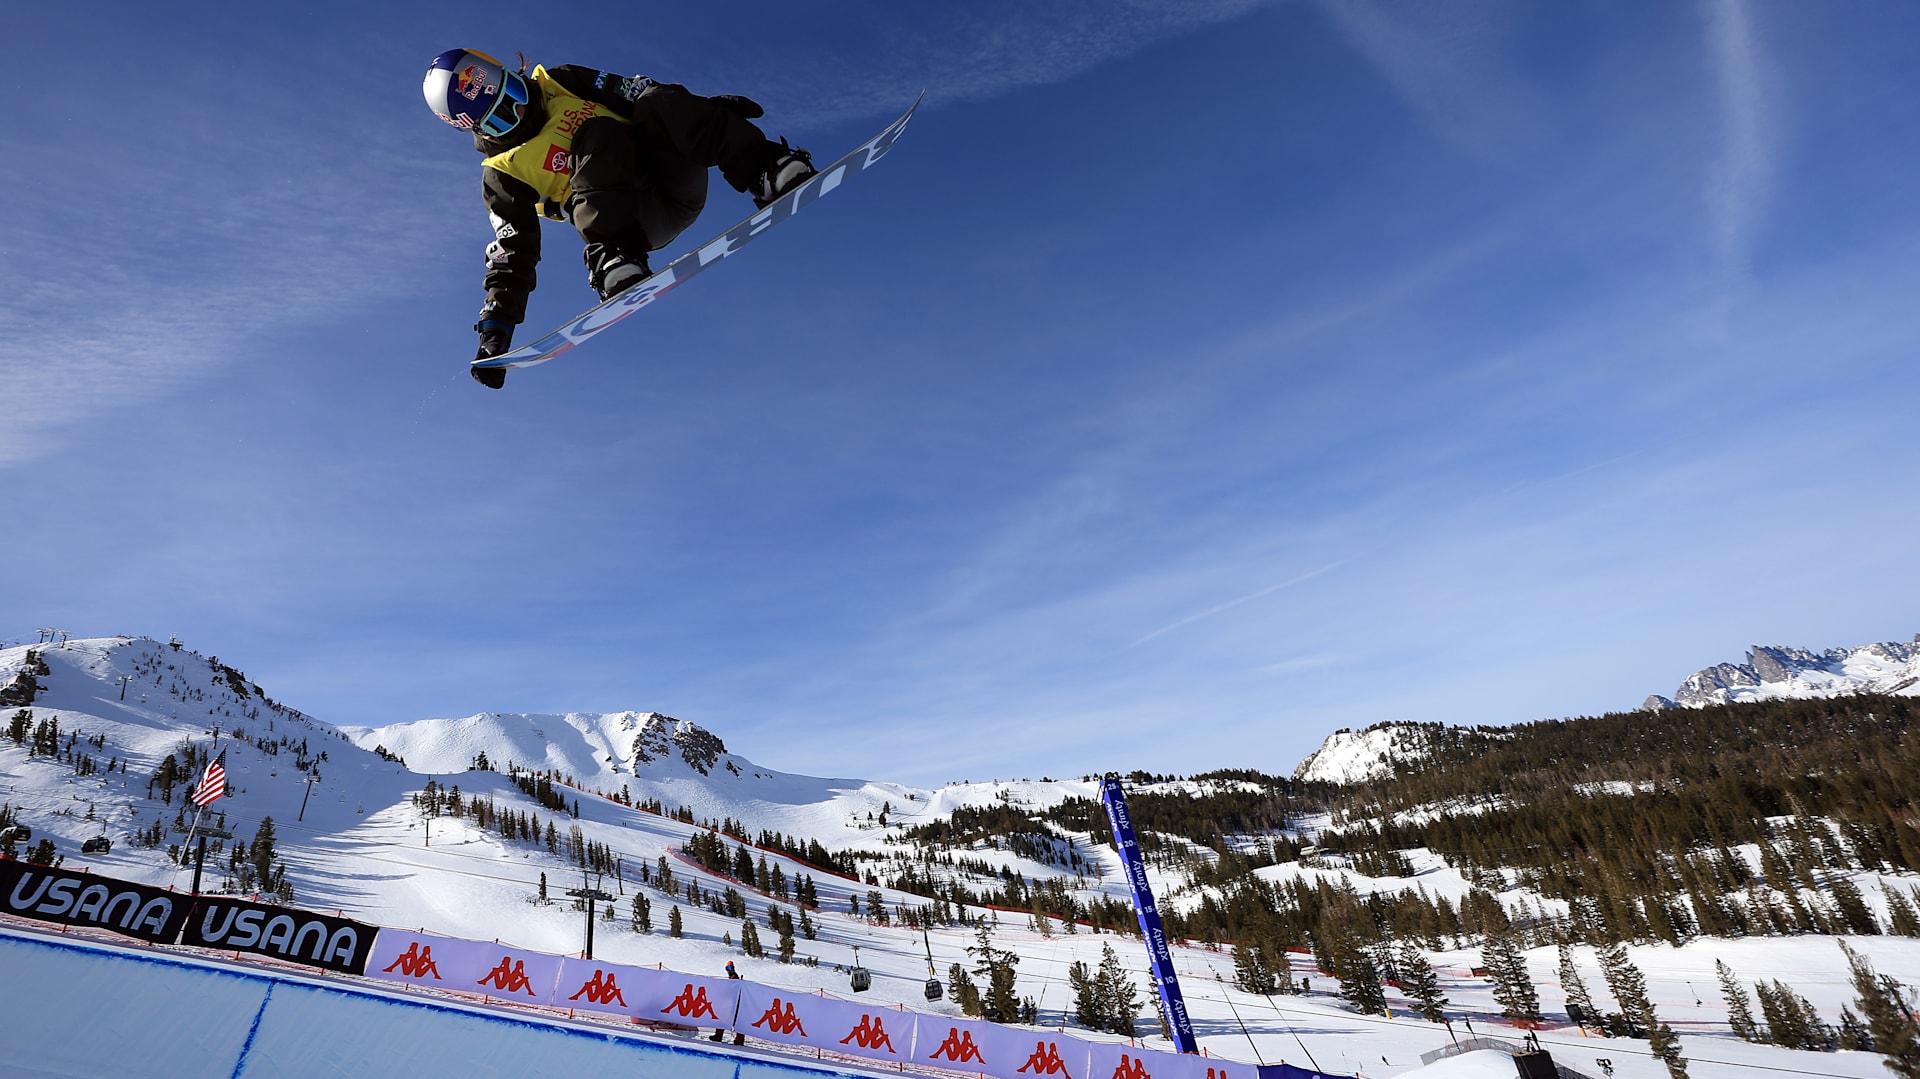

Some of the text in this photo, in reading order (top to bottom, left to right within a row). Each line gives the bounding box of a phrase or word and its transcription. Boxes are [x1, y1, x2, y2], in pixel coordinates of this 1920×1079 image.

[465, 67, 487, 100] Red Bull
[557, 109, 579, 132] U.S.
[1115, 800, 1129, 829] xfinity
[1133, 860, 1147, 892] xfinity
[9, 872, 173, 935] USANA
[1144, 905, 1152, 913] 15
[201, 905, 358, 967] USANA
[1153, 928, 1168, 961] xfinity
[1165, 976, 1174, 984] 10
[1174, 999, 1190, 1034] xfinity
